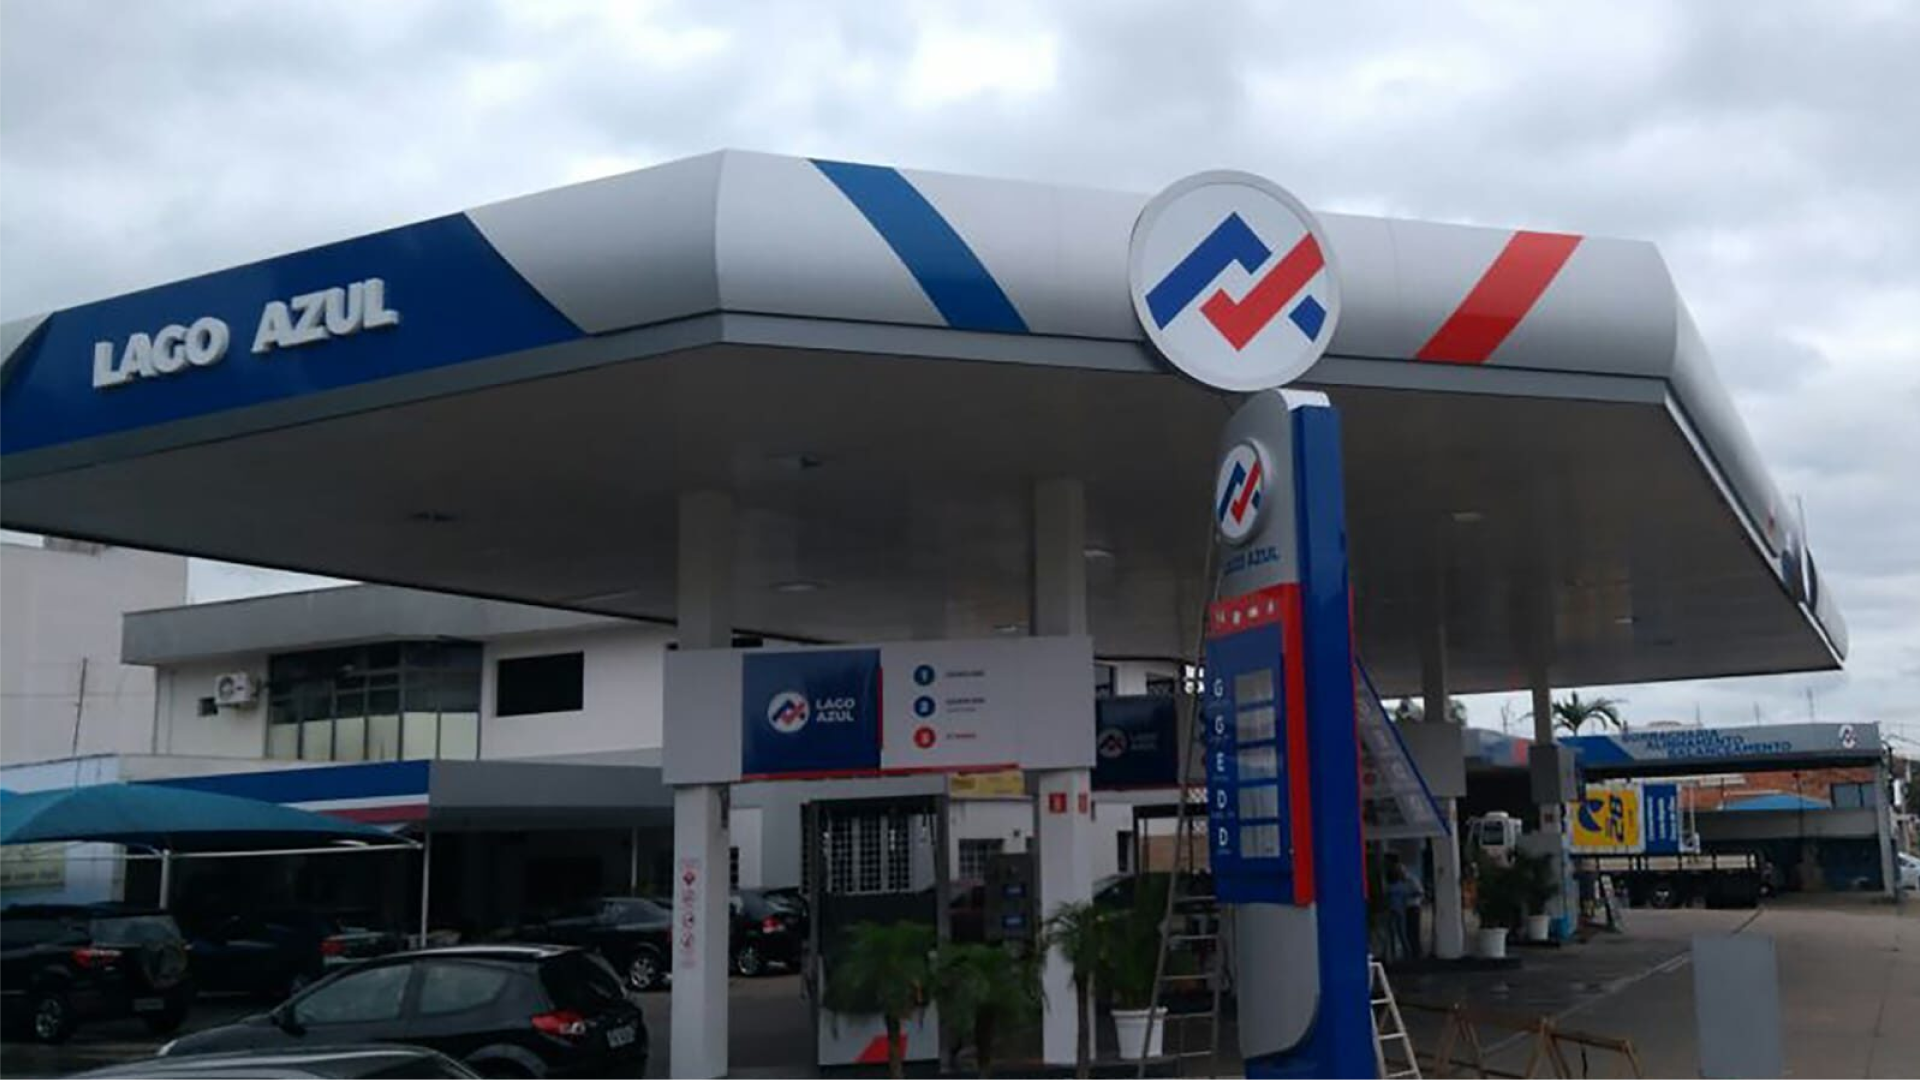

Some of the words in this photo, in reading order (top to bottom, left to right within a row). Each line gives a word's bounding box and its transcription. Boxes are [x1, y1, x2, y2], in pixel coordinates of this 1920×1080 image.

[93, 316, 230, 388] LAGO
[251, 277, 399, 353] AZUL
[1213, 678, 1224, 698] G
[816, 698, 856, 710] LAGO
[816, 711, 855, 723] AZUL
[1215, 715, 1225, 735] G
[1216, 752, 1225, 772] E
[1216, 788, 1228, 810] D
[1218, 826, 1229, 846] D
